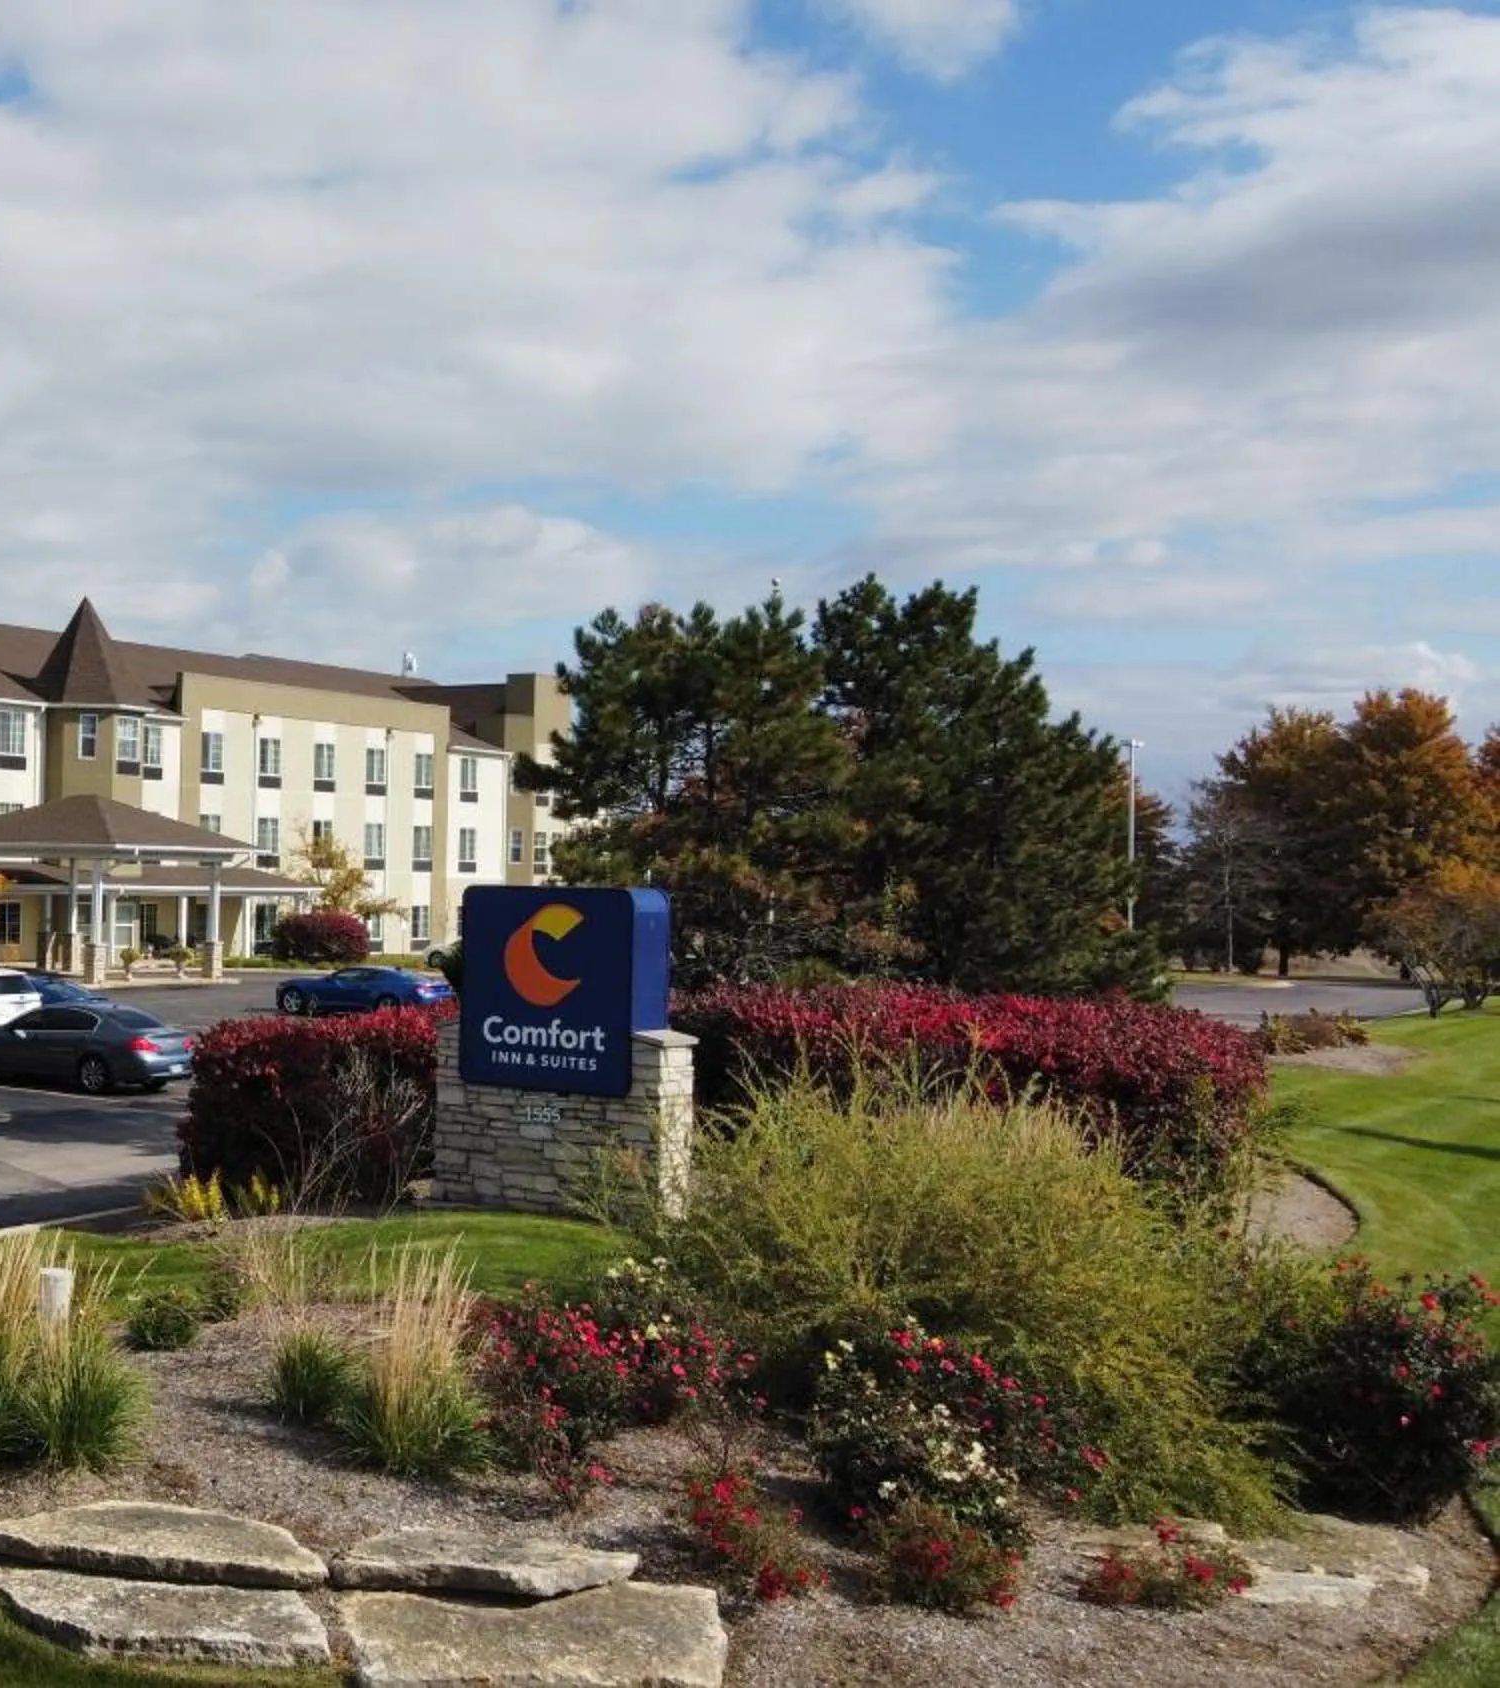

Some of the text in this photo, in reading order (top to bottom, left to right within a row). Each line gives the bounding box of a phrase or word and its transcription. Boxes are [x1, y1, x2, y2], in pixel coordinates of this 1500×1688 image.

[482, 1015, 605, 1052] Comfort
[491, 1050, 597, 1071] INN & SUITES
